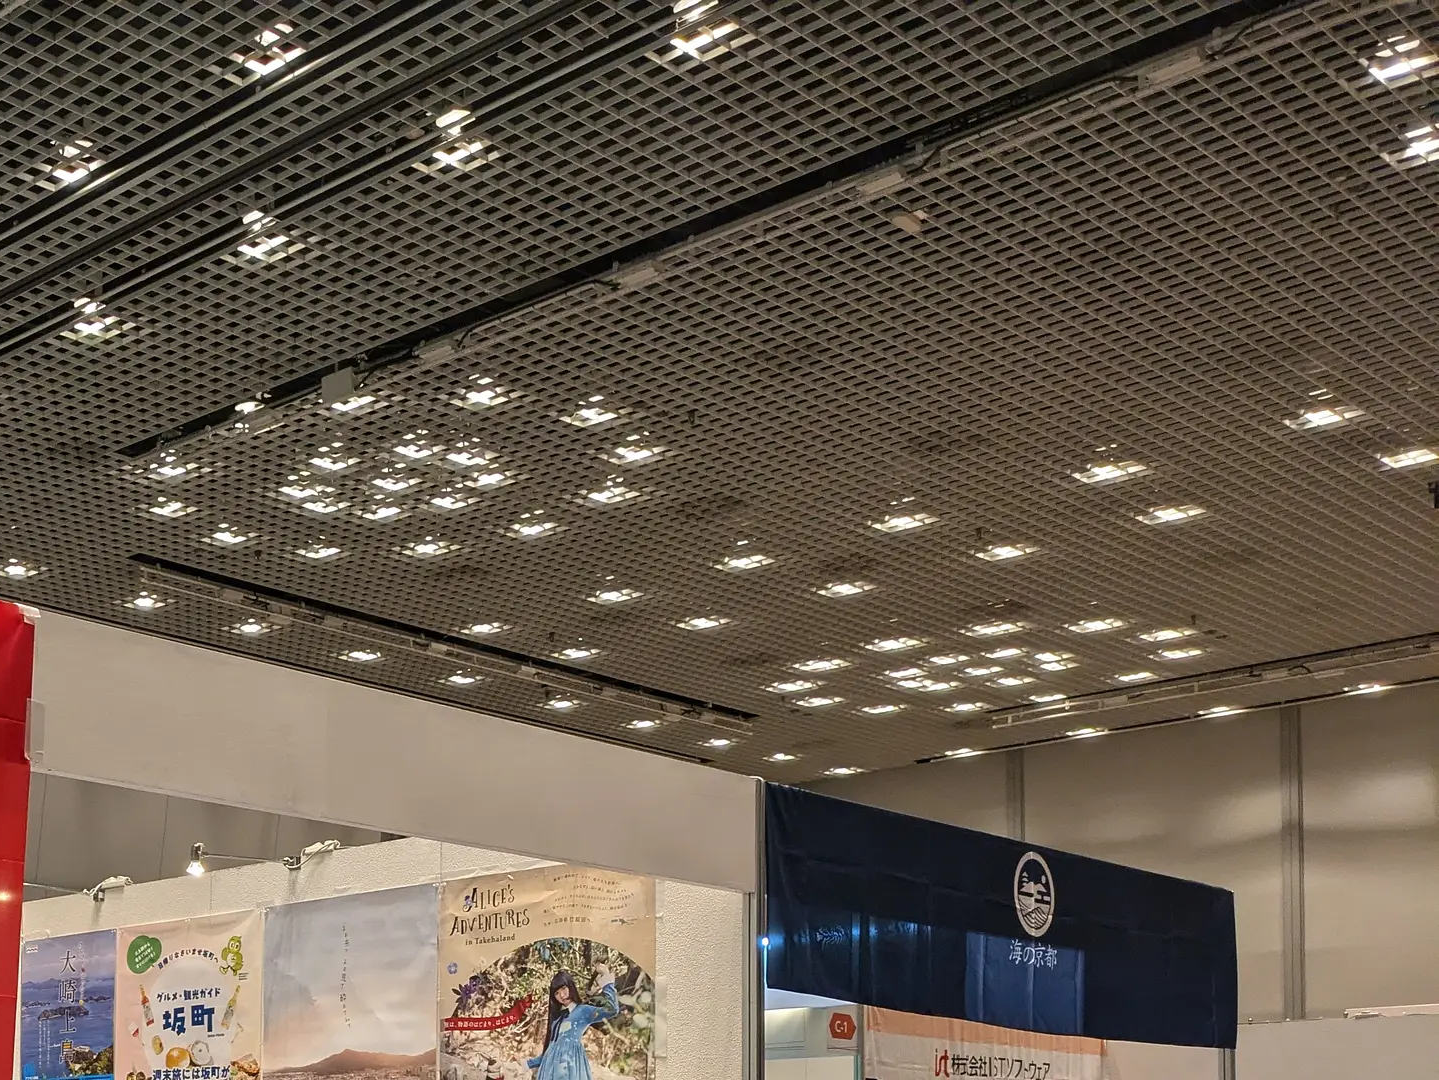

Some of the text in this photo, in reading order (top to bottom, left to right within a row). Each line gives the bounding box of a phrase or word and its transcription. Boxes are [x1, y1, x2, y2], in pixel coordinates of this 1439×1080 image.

[462, 884, 515, 912] ALICE'S
[449, 908, 530, 936] ADVENTURES
[465, 934, 516, 946] in Takehaland
[1009, 939, 1057, 970] 海の京都
[59, 950, 76, 1064] 大崎上島
[157, 987, 221, 1003] グルメ・観光ガイド
[162, 1004, 215, 1036] 坂町
[834, 1021, 849, 1034] C-1
